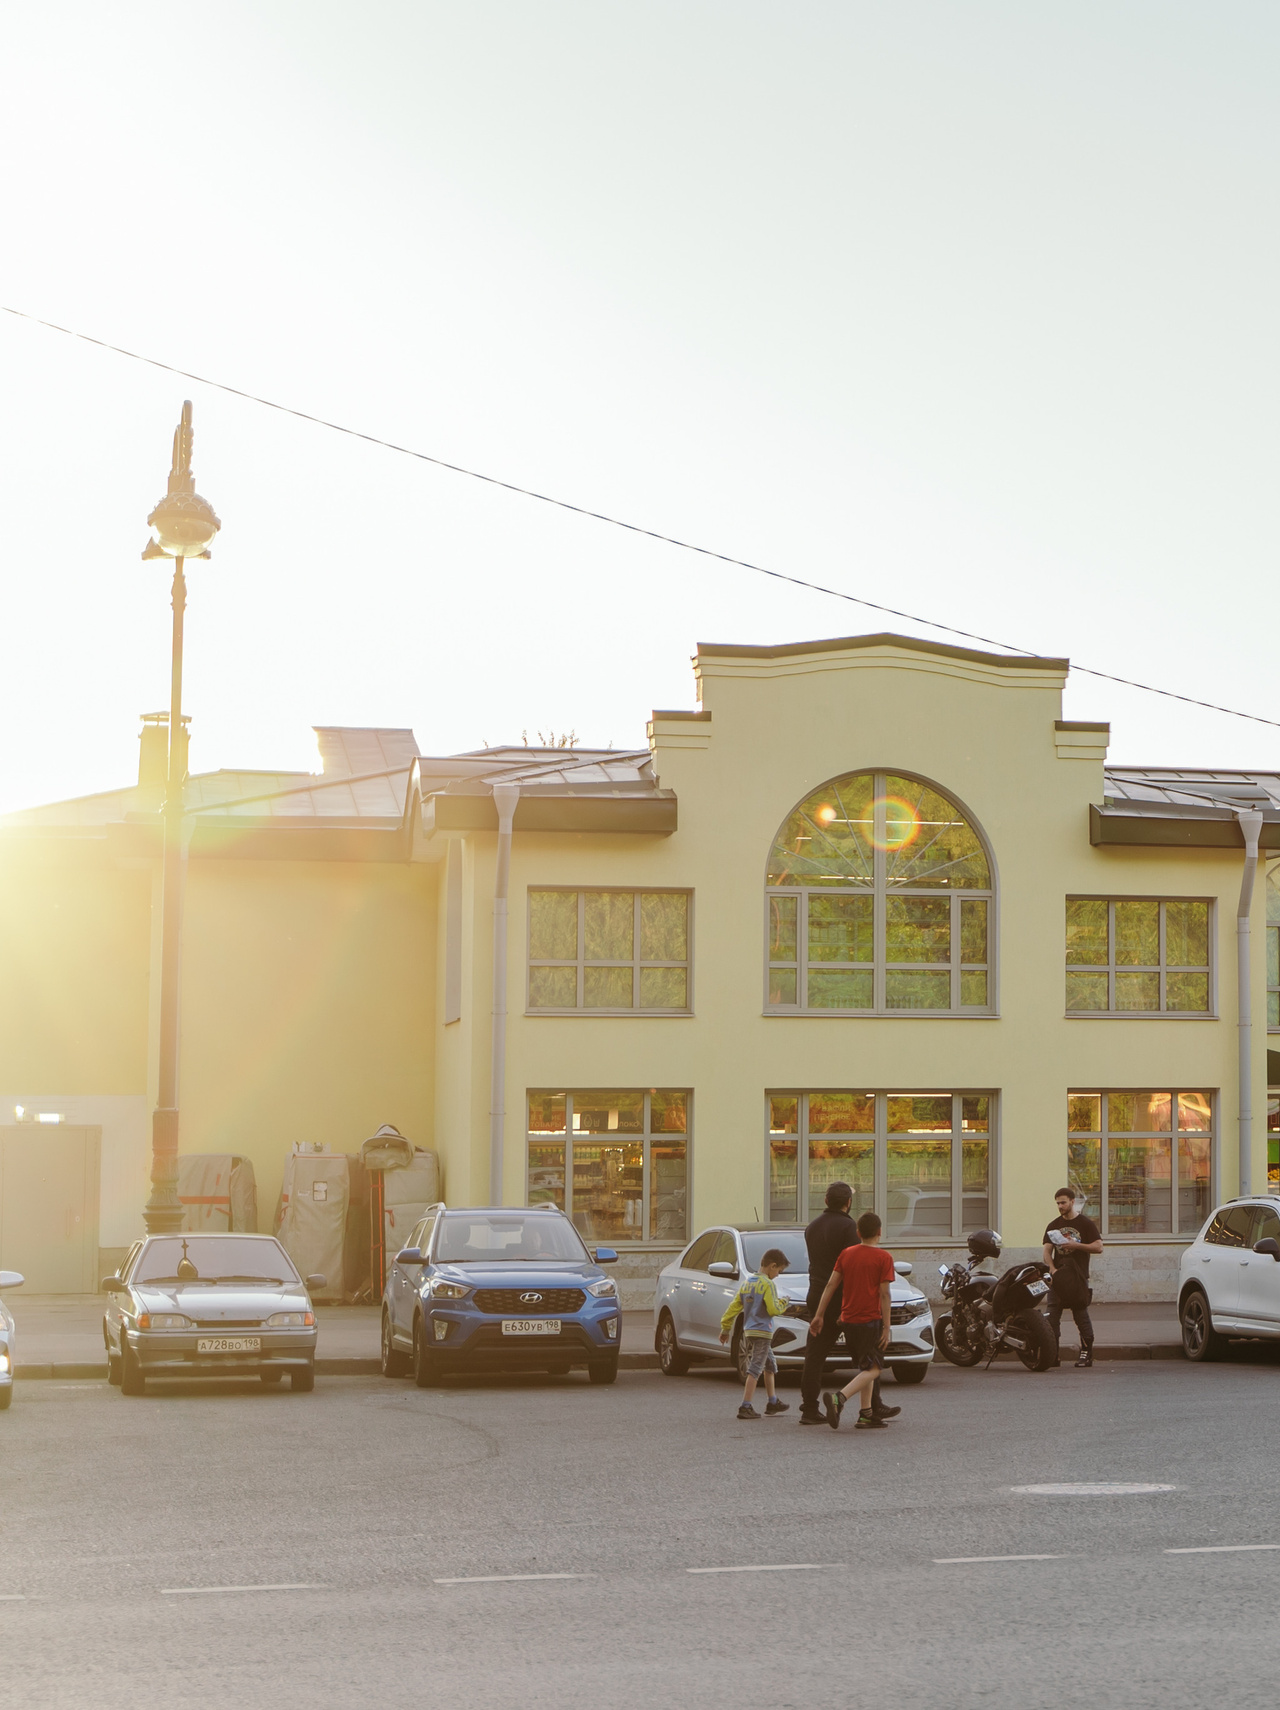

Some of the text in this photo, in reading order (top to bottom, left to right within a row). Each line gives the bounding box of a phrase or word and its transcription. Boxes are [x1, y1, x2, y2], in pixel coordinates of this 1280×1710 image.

[504, 1321, 559, 1331] Е630УВ 198
[200, 1339, 259, 1350] А728ВО 198
